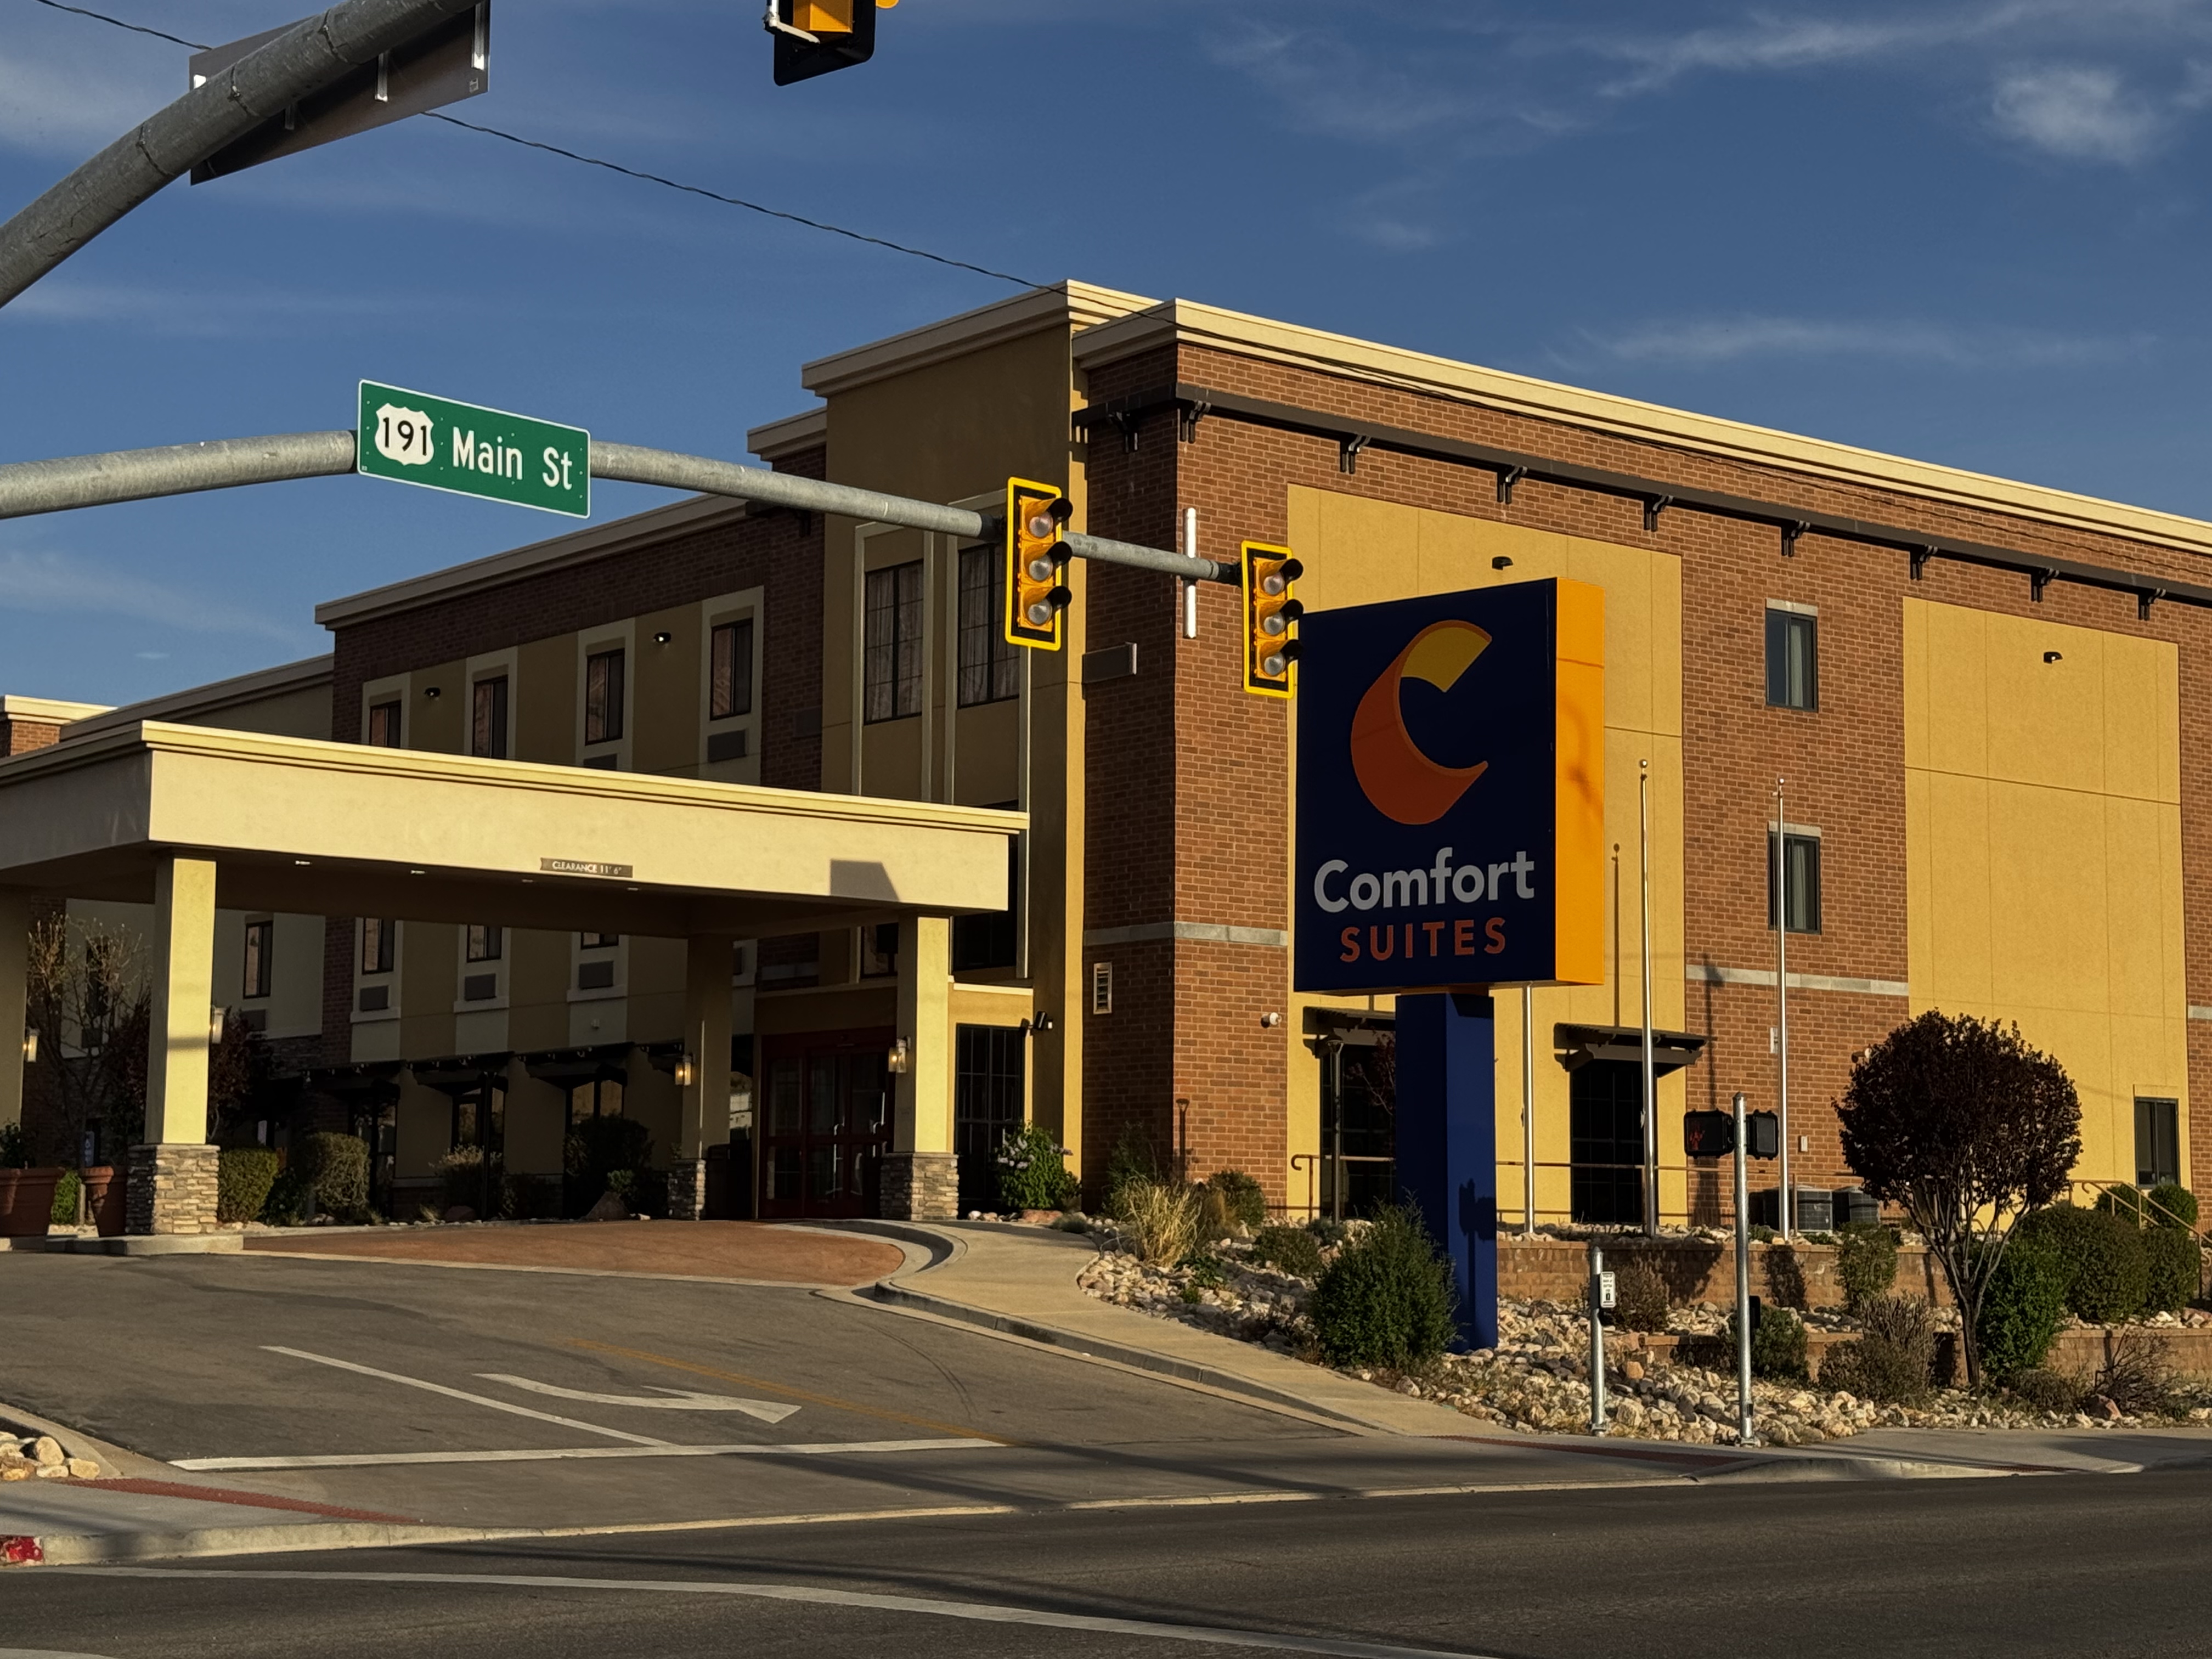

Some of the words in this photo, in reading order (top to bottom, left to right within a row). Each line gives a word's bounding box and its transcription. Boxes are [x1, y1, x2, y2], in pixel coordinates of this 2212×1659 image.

[383, 417, 427, 456] 191
[453, 426, 523, 480] Main
[543, 447, 573, 490] St
[552, 861, 598, 873] CLEARANCE
[1314, 847, 1534, 913] Comfort
[1340, 917, 1506, 962] SUITES
